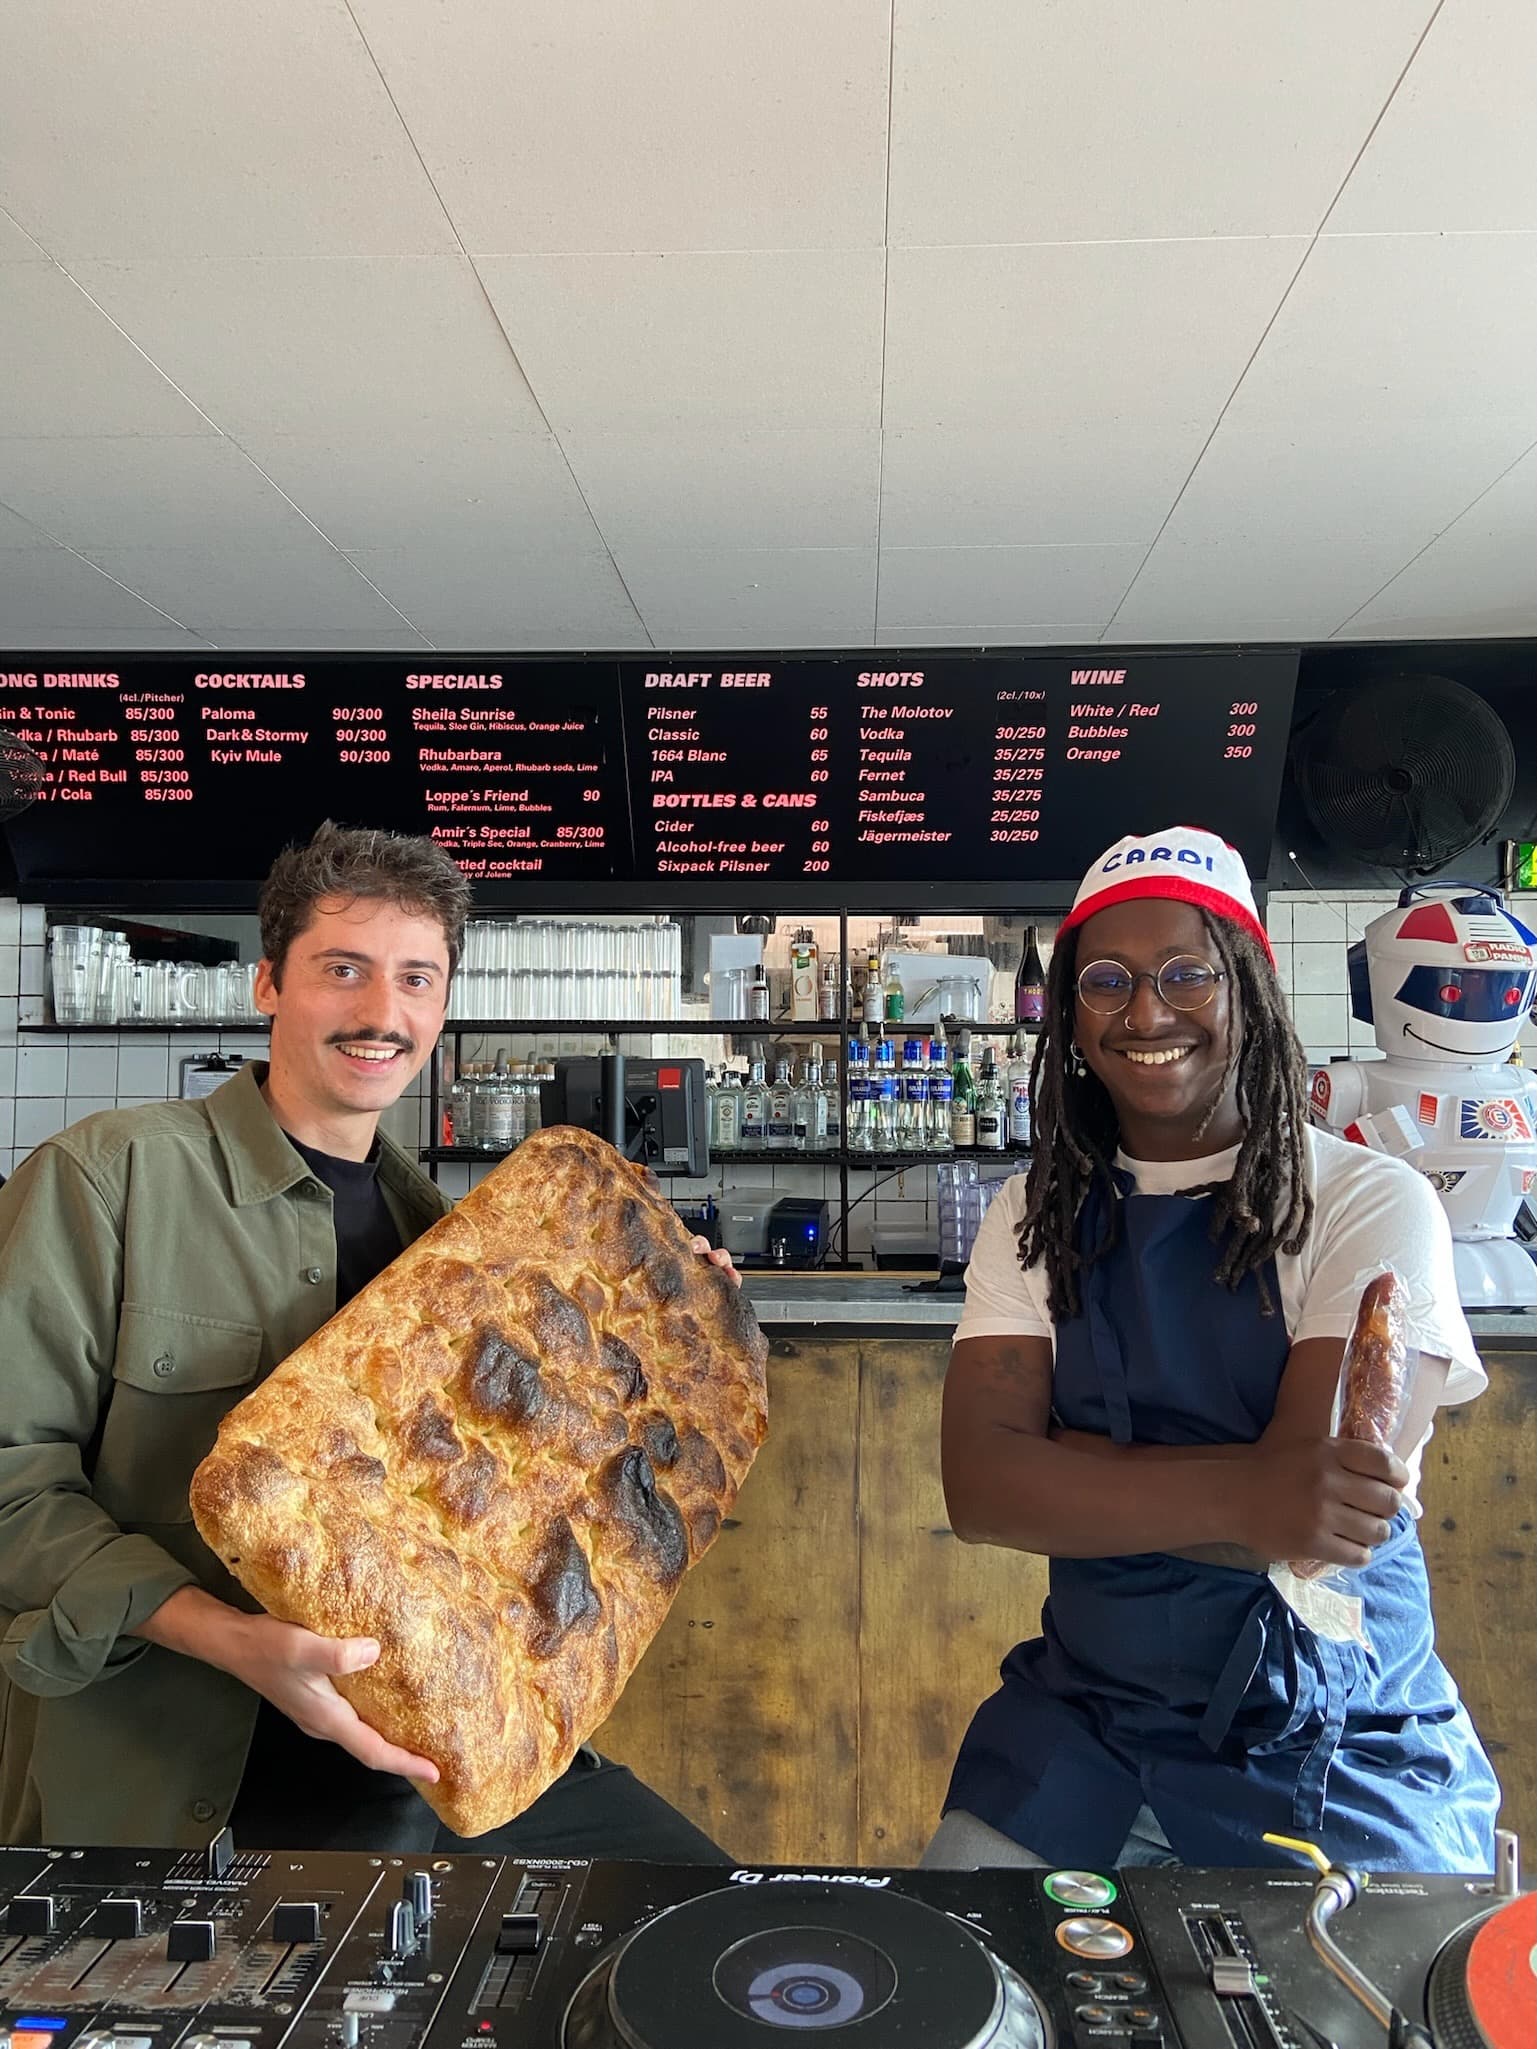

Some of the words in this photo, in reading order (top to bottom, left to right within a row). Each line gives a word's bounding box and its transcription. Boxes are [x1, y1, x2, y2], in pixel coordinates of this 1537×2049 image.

[44, 674, 119, 688] DRINKS
[195, 674, 305, 688] COCKTAILS
[406, 675, 502, 689] SPECIALS
[645, 674, 712, 687] DRAFT
[720, 673, 771, 687] BEER
[857, 672, 924, 687] SHOTS
[1071, 670, 1126, 684] WINE
[997, 691, 1045, 700] (2cl./10x)
[0, 708, 15, 719] in
[20, 707, 31, 719] &
[35, 707, 75, 719] Tonic
[126, 708, 174, 721] 85/300
[202, 707, 255, 719] Paloma
[333, 708, 382, 721] 90/300
[412, 708, 456, 720] Sheila
[460, 708, 515, 720] Sunrise
[648, 708, 696, 719] Pilsner
[810, 707, 828, 719] 55
[861, 706, 887, 718] The
[891, 706, 953, 718] Molotov
[1071, 705, 1114, 717] White
[1117, 704, 1126, 717] /
[1129, 704, 1160, 716] Red
[1230, 703, 1257, 715] 300
[413, 722, 446, 731] Tequila,
[449, 722, 468, 730] Sloe
[469, 722, 487, 731] Gin,
[489, 722, 527, 731] Hibiscus,
[529, 722, 560, 731] Orange
[562, 722, 584, 730] Juice
[1068, 726, 1128, 738] Bubbles
[1227, 724, 1255, 736] 300
[12, 729, 42, 741] dka
[47, 729, 52, 742] /
[57, 729, 118, 741] Rhubarb
[131, 729, 179, 742] 85/300
[336, 729, 386, 742] 90/300
[648, 728, 699, 740] Classic
[810, 728, 828, 740] 60
[860, 728, 904, 739] Vodka
[995, 727, 1046, 740] 30/250
[52, 749, 58, 762] /
[63, 749, 99, 761] Maté
[136, 749, 184, 762] 85/300
[211, 750, 242, 764] Kyiv
[246, 750, 282, 762] Mule
[340, 750, 390, 763] 90/300
[419, 748, 501, 760] Rhubarbara
[652, 750, 683, 761] 1664
[688, 750, 727, 761] Blanc
[811, 749, 828, 761] 65
[860, 749, 912, 763] Tequila
[994, 748, 1045, 761] 35/275
[1067, 747, 1120, 762] Orange
[1224, 746, 1252, 758] 350
[420, 763, 448, 771] Vodka,
[483, 764, 513, 772] Aperol,
[553, 764, 575, 772] soda,
[58, 770, 64, 782] /
[68, 770, 96, 782] Red
[100, 770, 127, 782] Bull
[141, 770, 189, 783] 85/300
[651, 770, 673, 782] IPA
[811, 770, 828, 781] 60
[859, 769, 905, 781] Fernet
[993, 769, 1044, 781] 35/275
[51, 789, 56, 800] /
[61, 788, 92, 800] Cola
[145, 789, 193, 801] 85/300
[484, 790, 528, 801] Friend
[583, 790, 600, 801] 90
[653, 794, 736, 807] BOTTLES
[741, 794, 757, 807] &
[763, 794, 817, 807] CANS
[859, 790, 925, 801] Sambuca
[992, 790, 1042, 802] 35/275
[428, 804, 449, 812] Rum,
[494, 804, 517, 812] Lime,
[859, 810, 924, 824] Fiskefjæs
[991, 810, 1039, 822] 25/250
[480, 826, 530, 840] Special
[557, 827, 604, 838] 85/300
[655, 821, 694, 832] Cider
[811, 821, 829, 831] 60
[858, 830, 952, 844] Jägermeister
[990, 830, 1039, 842] 30/250
[462, 840, 486, 848] Triple
[487, 840, 504, 848] Sec,
[507, 840, 538, 848] Orange,
[540, 840, 583, 848] Cranberry,
[656, 841, 746, 852] Alcohol-free
[751, 841, 785, 852] beer
[812, 841, 829, 852] 60
[455, 859, 486, 870] tled
[489, 859, 542, 870] cocktail
[1102, 847, 1213, 872] CARDI
[658, 860, 714, 873] Sixpack
[720, 860, 770, 871] Pilsner
[803, 861, 829, 871] 200
[1488, 943, 1526, 954] RADIO
[768, 1874, 892, 1888] Pioneer
